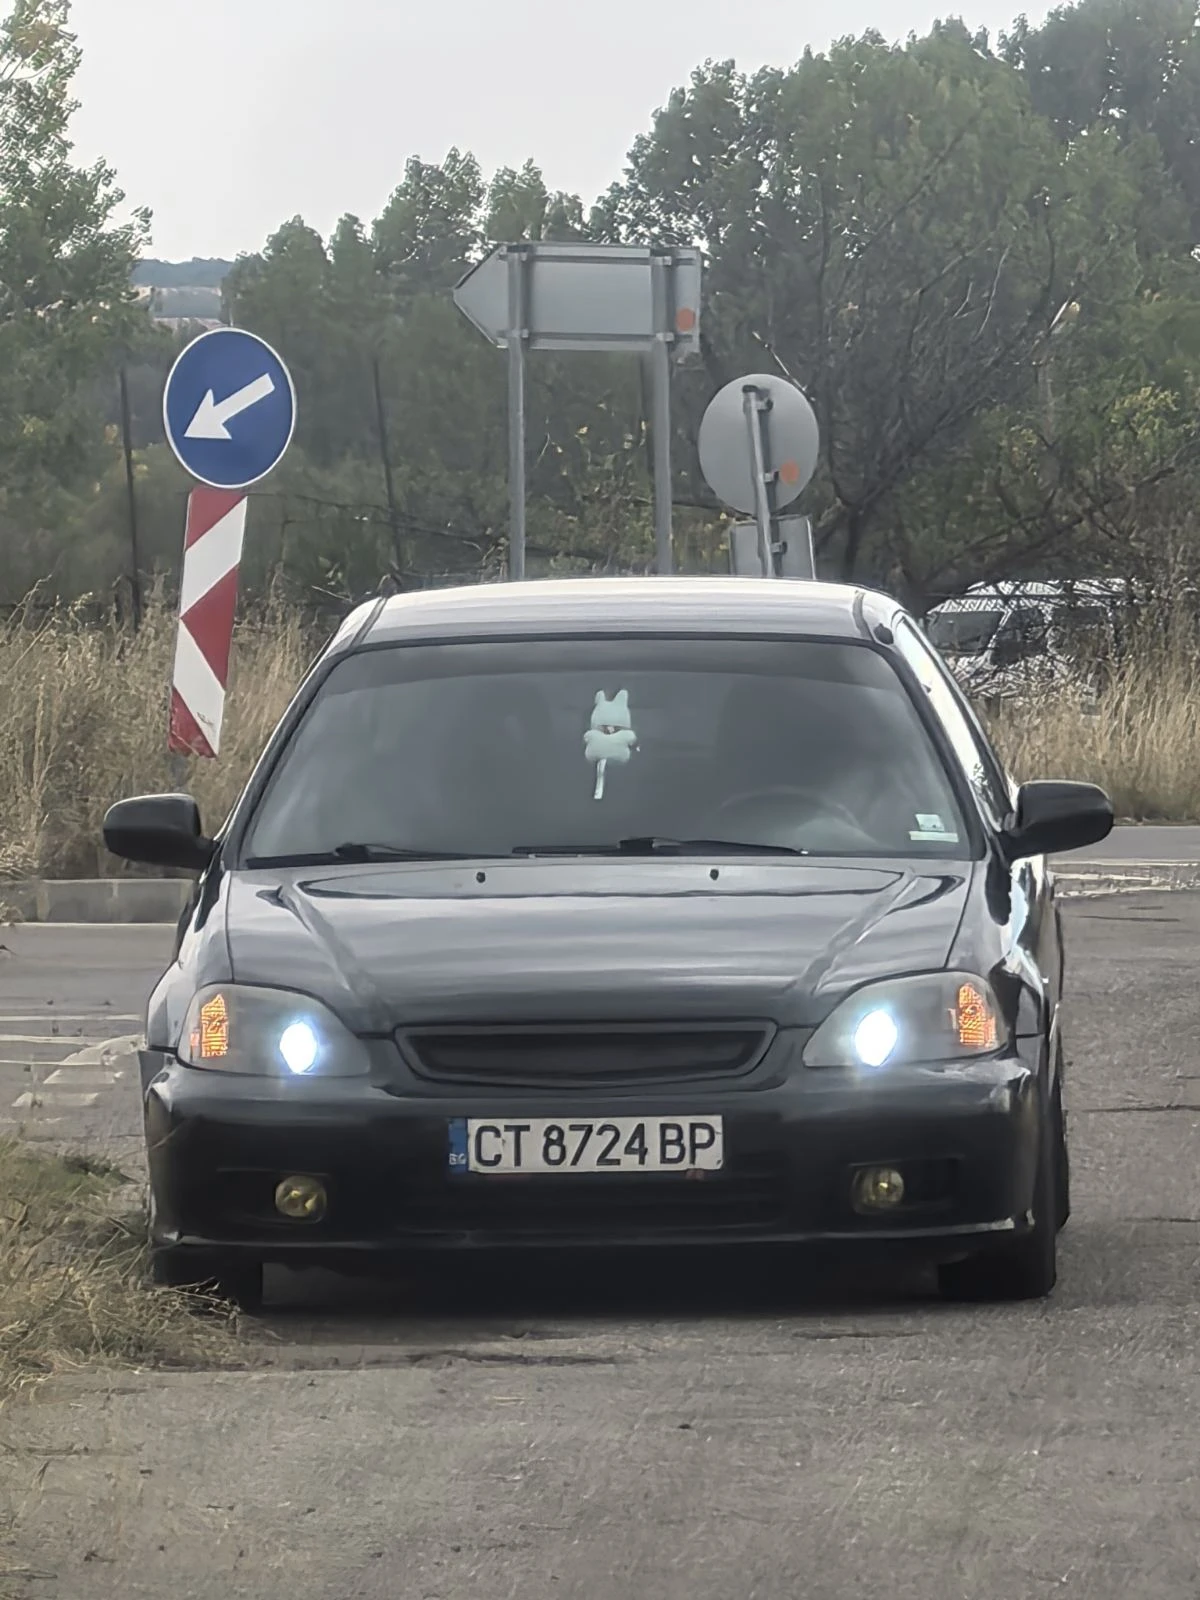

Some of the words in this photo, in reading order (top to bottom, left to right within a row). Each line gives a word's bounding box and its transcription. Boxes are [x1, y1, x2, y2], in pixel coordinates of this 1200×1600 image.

[474, 1124, 531, 1167] CT
[542, 1123, 648, 1166] 8724
[659, 1122, 715, 1165] BP
